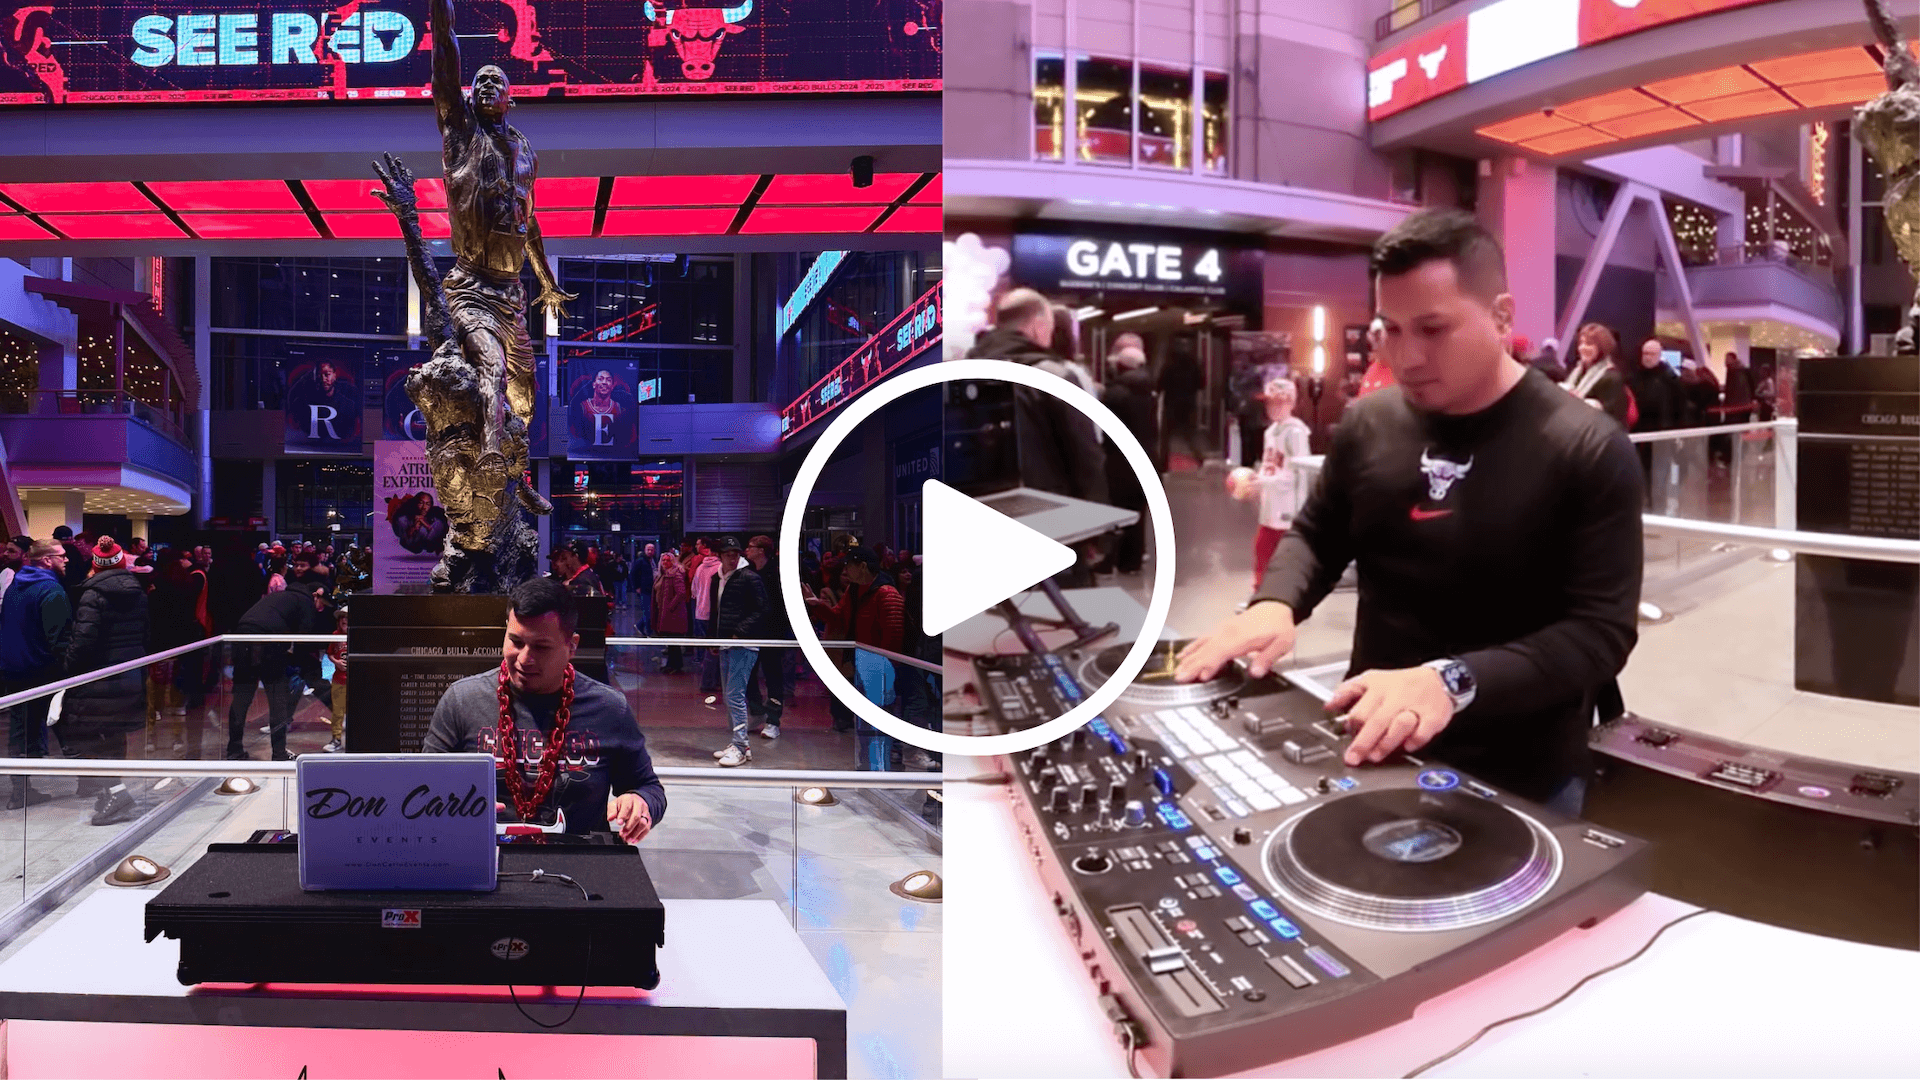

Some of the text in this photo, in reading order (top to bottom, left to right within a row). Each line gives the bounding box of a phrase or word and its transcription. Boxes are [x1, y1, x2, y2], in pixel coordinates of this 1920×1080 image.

[130, 11, 416, 67] SEE RED
[772, 83, 810, 92] CHICAGO
[811, 83, 837, 91] BULLS
[838, 83, 859, 91] 2024
[1066, 240, 1222, 283] GATE 4
[307, 404, 341, 440] R
[594, 413, 615, 446] E
[896, 457, 928, 478] UNITED
[410, 646, 443, 656] CHICAGO
[446, 646, 469, 655] BULLS
[305, 784, 487, 820] Don Carlo
[356, 836, 438, 844] EVENTS
[384, 910, 420, 923] ProX
